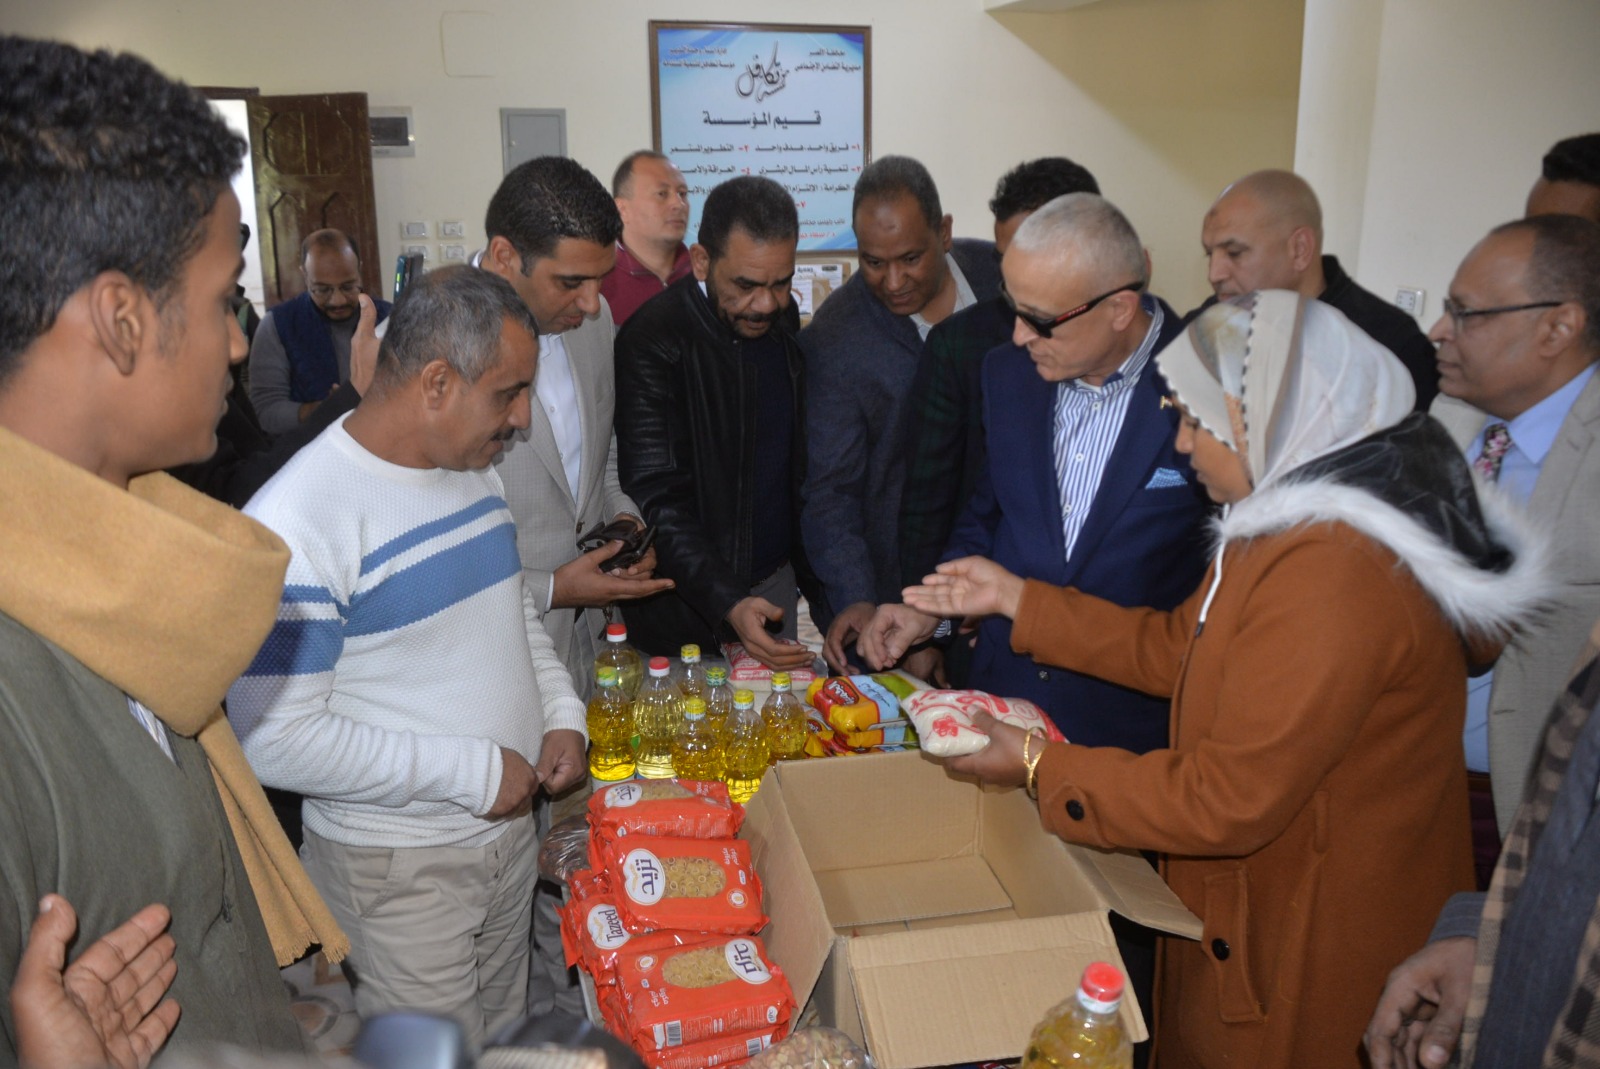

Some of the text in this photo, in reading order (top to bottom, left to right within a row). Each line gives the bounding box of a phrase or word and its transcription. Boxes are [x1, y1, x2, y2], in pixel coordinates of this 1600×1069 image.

[702, 110, 822, 129] قيم المؤسسة
[634, 859, 659, 896] تزيد
[598, 909, 625, 943] Tazeed
